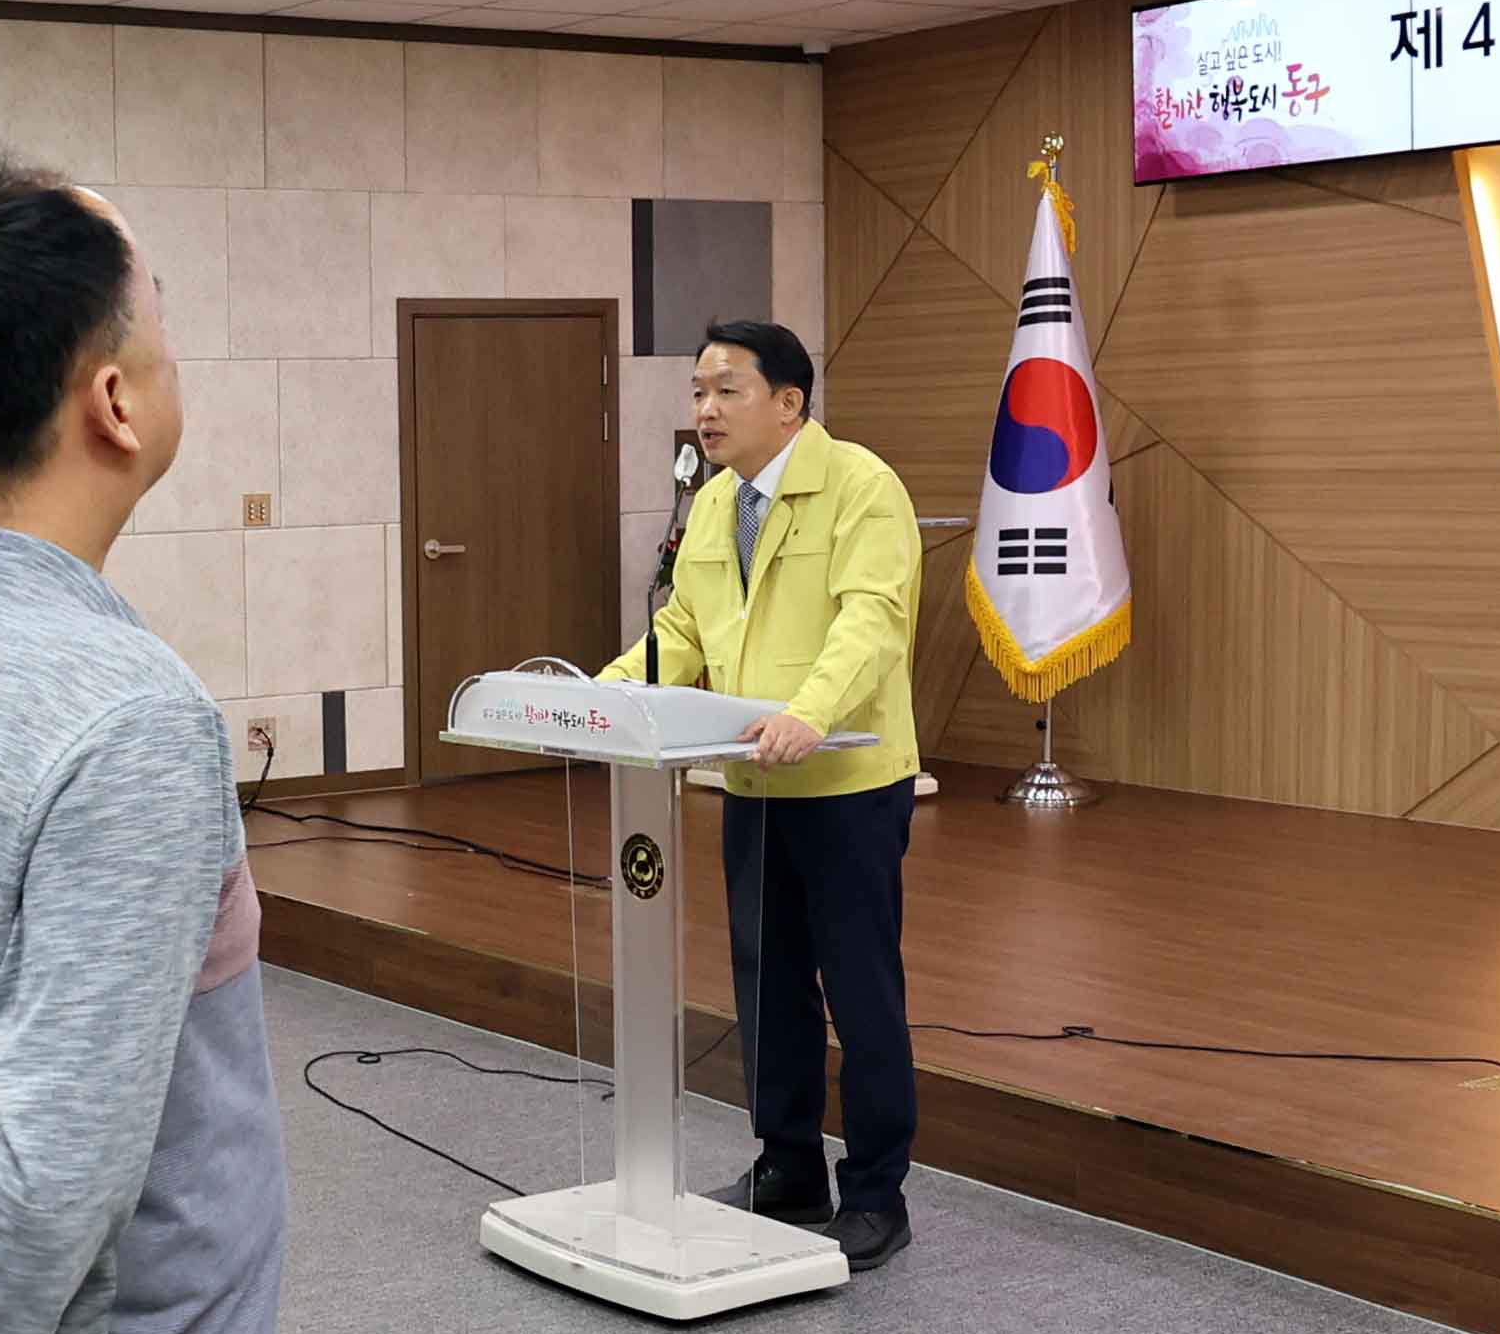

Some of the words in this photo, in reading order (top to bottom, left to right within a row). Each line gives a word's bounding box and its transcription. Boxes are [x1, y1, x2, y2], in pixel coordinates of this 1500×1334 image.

[1154, 87, 1204, 129] 활기찬
[1209, 75, 1277, 123] 행복도시
[1281, 63, 1331, 117] 동구
